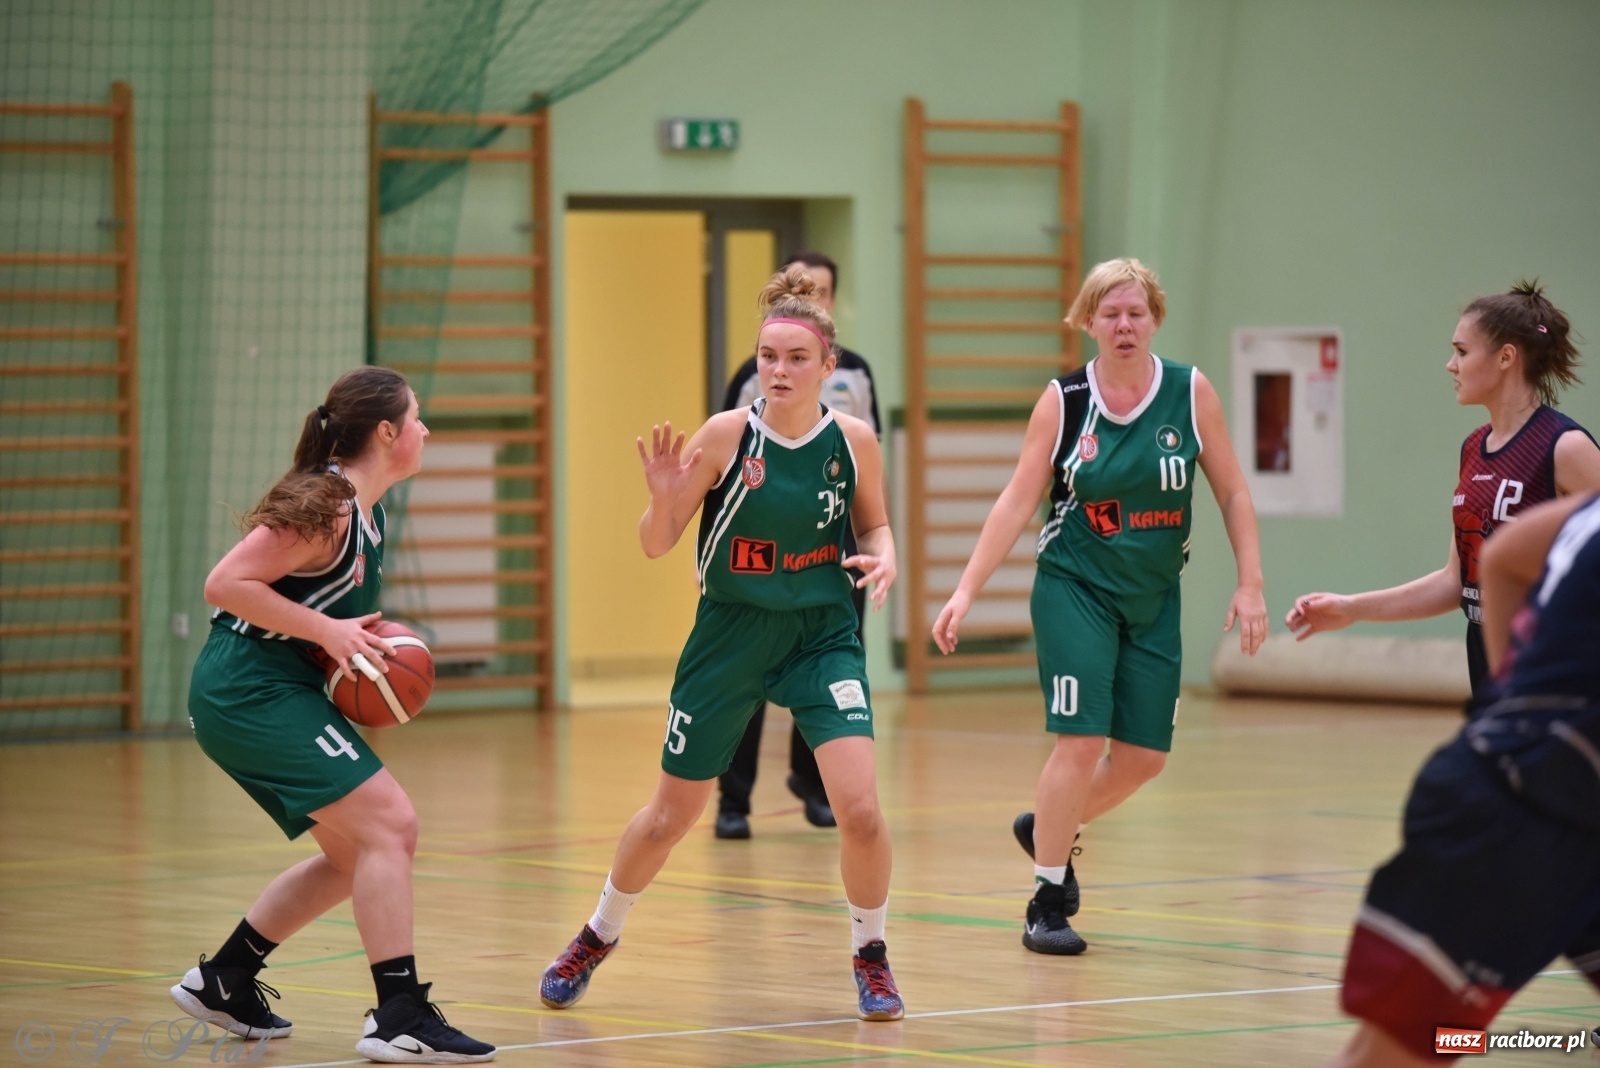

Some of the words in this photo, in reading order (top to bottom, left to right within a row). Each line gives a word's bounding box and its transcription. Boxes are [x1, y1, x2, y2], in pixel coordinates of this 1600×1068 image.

[1063, 382, 1089, 394] COLO
[1159, 456, 1187, 491] 10
[816, 481, 847, 530] 35
[1084, 502, 1120, 534] K
[1129, 507, 1184, 529] KAMA
[1492, 478, 1524, 524] 12
[733, 540, 772, 571] K
[1051, 674, 1079, 716] 10
[315, 723, 360, 761] 4
